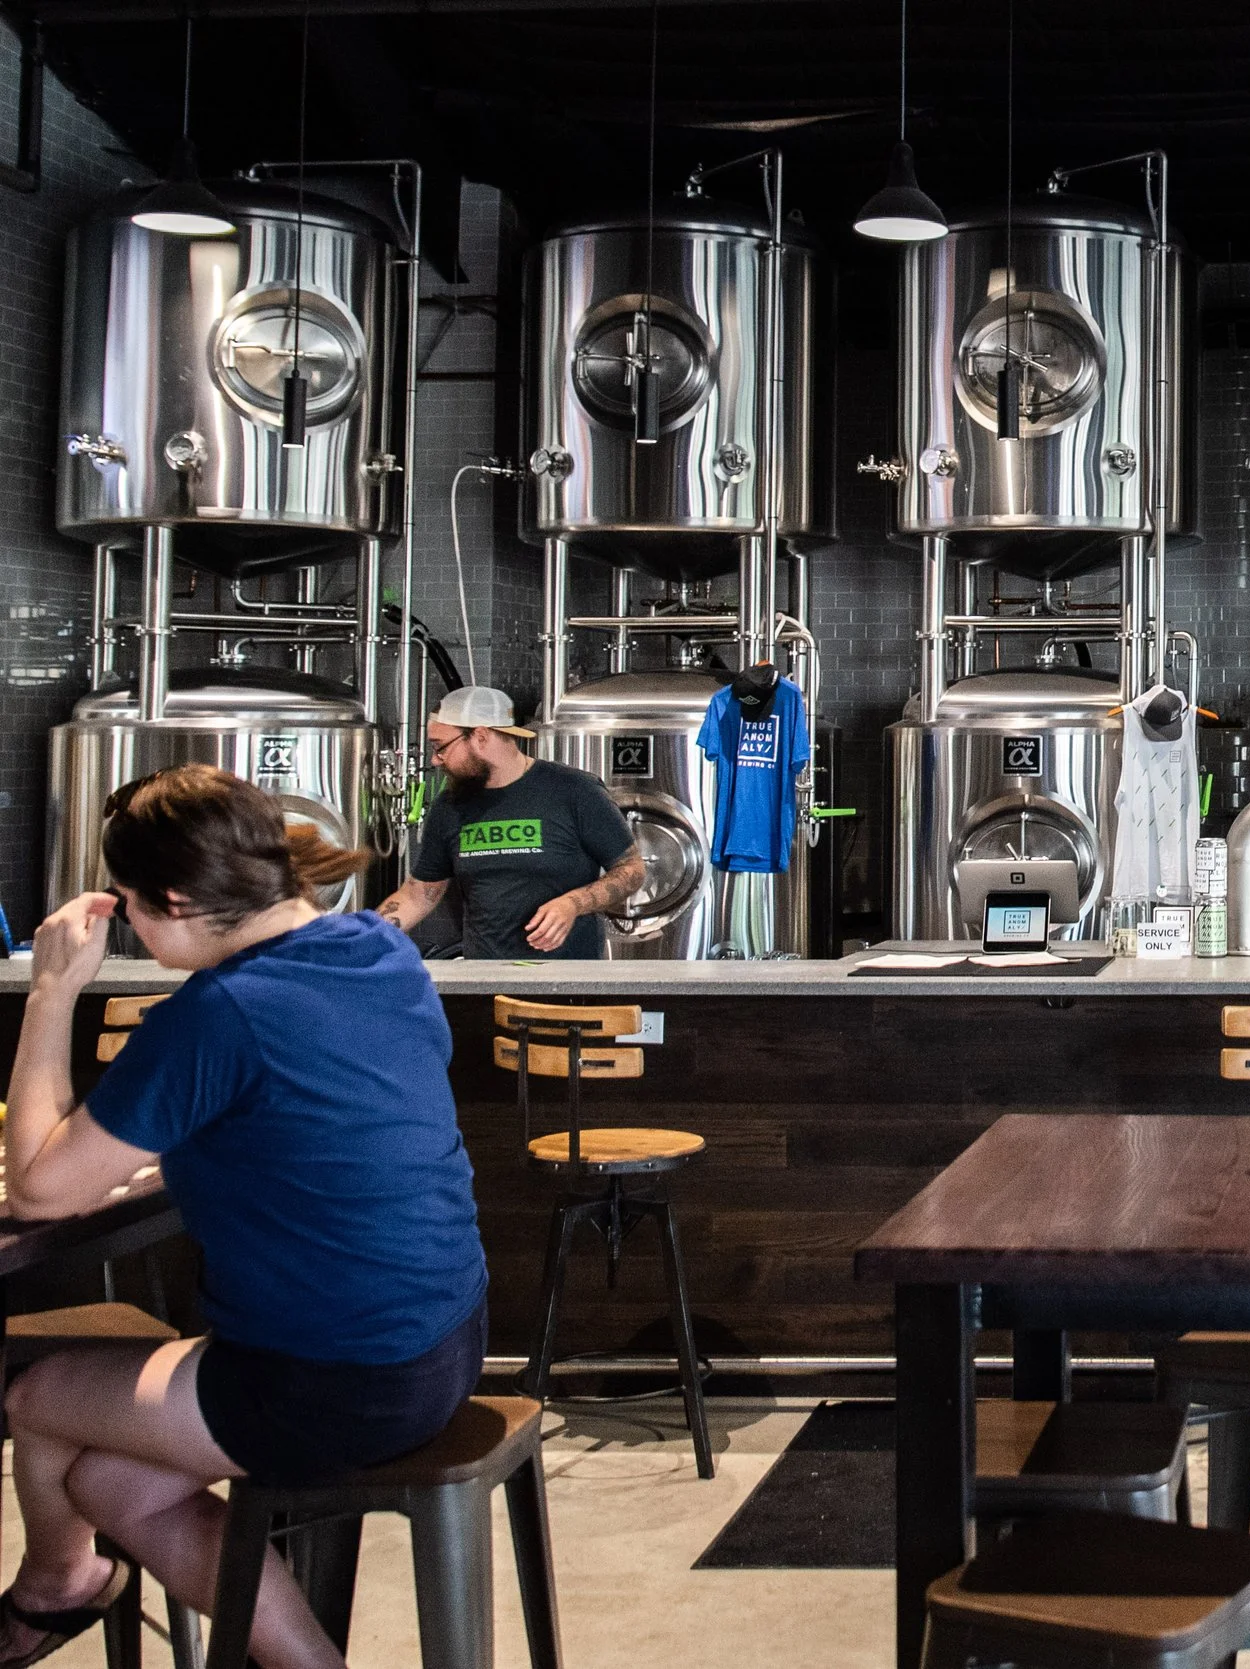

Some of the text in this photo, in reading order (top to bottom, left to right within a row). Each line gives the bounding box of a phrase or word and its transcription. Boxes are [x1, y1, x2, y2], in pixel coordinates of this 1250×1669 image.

[745, 722, 773, 731] TRUE
[1137, 928, 1181, 937] SERVICE
[1145, 942, 1172, 951] ONLY
